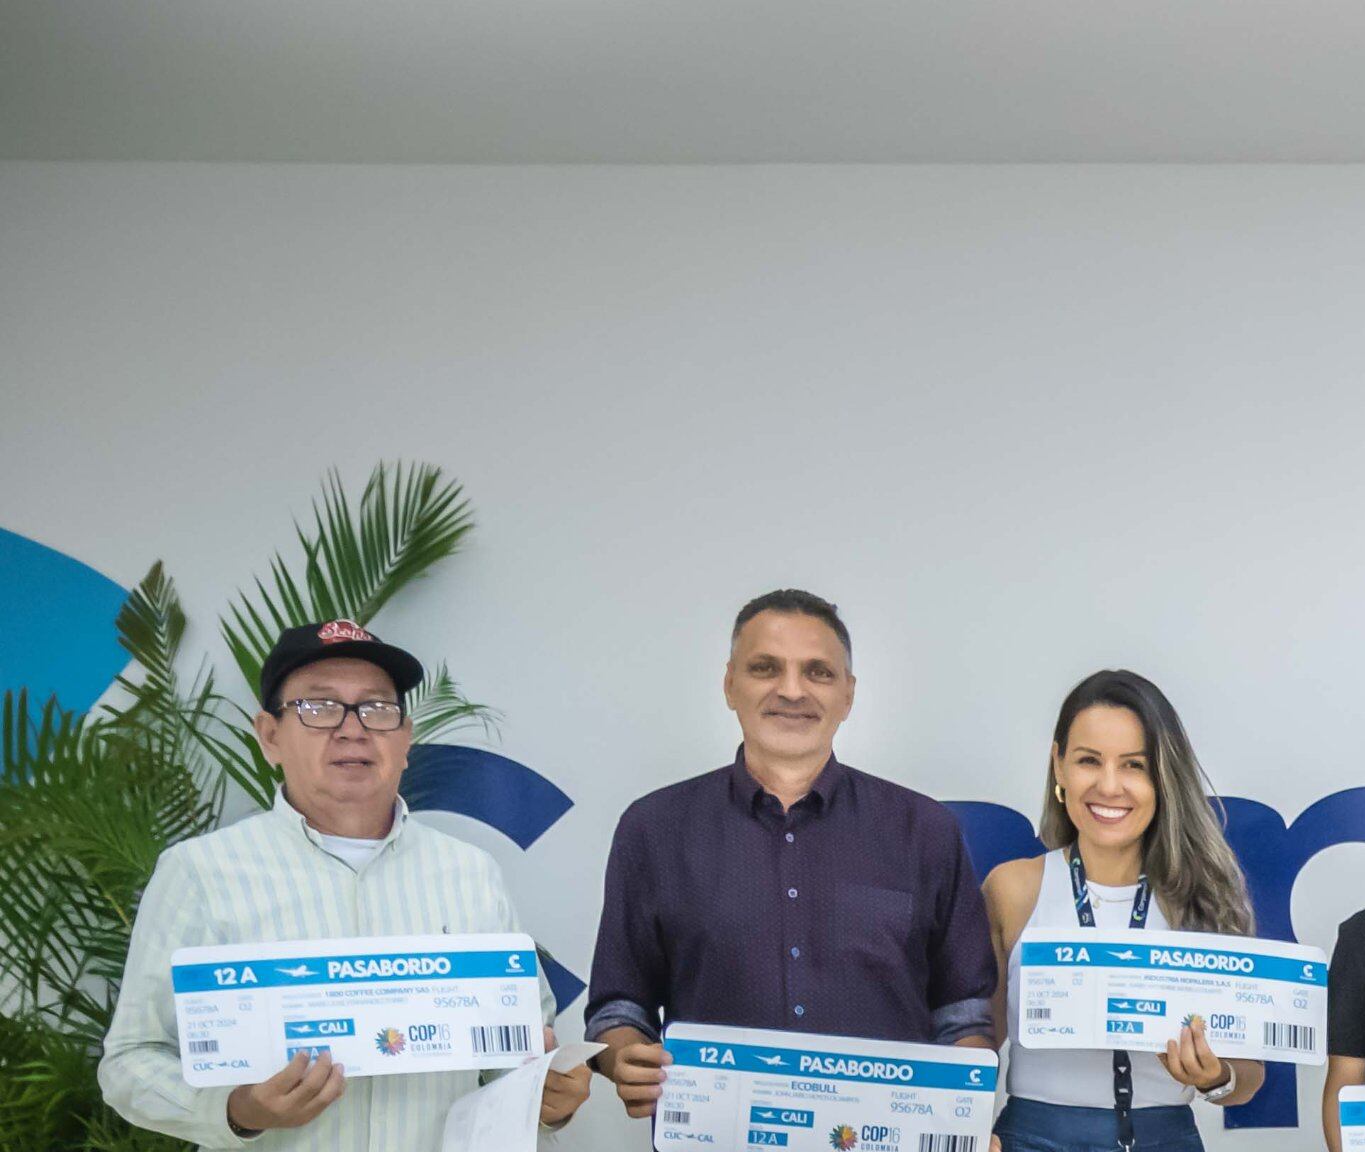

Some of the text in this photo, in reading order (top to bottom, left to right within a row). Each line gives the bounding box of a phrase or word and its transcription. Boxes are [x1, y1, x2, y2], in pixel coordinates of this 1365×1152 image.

[1055, 947, 1254, 973] 12 A PASABORDO
[214, 957, 451, 986] 12 A PASABORDO
[434, 996, 480, 1008] 95678A
[1235, 991, 1275, 1005] 95678A
[1136, 1001, 1160, 1012] CALI
[319, 1022, 348, 1033] CALI
[1210, 1013, 1246, 1030] COP16
[408, 1023, 451, 1042] COP16
[1210, 1030, 1246, 1039] COLOMBIA
[410, 1042, 452, 1051] COLOMBIA
[700, 1046, 914, 1081] 12 A PASABORDO
[791, 1081, 838, 1094] ECOBULL
[891, 1102, 933, 1115] 95678A
[781, 1112, 807, 1123] CALI
[861, 1125, 900, 1144] COP16
[861, 1143, 899, 1152] COLOMBIA
